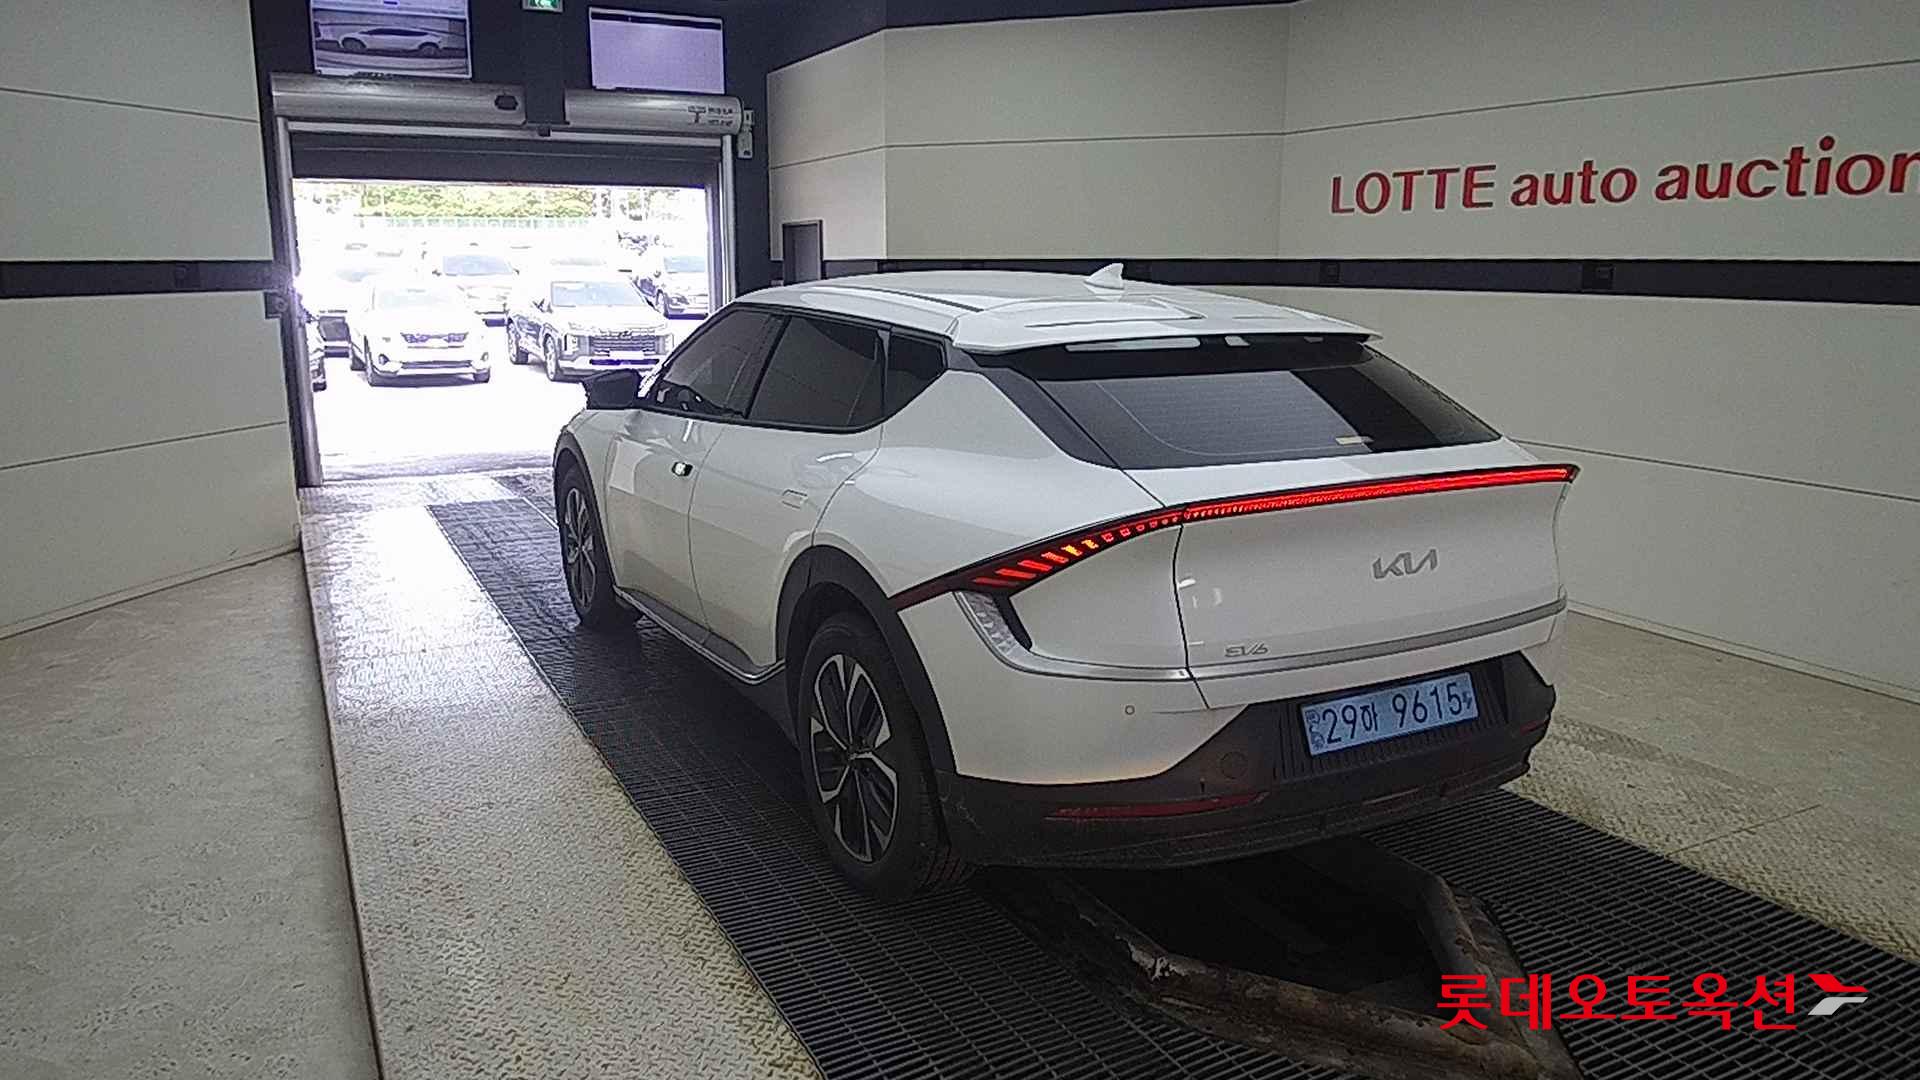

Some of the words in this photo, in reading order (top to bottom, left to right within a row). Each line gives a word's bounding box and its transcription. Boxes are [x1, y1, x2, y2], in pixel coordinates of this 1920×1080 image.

[1331, 164, 1497, 214] LOTTE
[1510, 160, 1637, 207] auto
[1225, 644, 1269, 659] EV6
[1392, 682, 1462, 728] 9615
